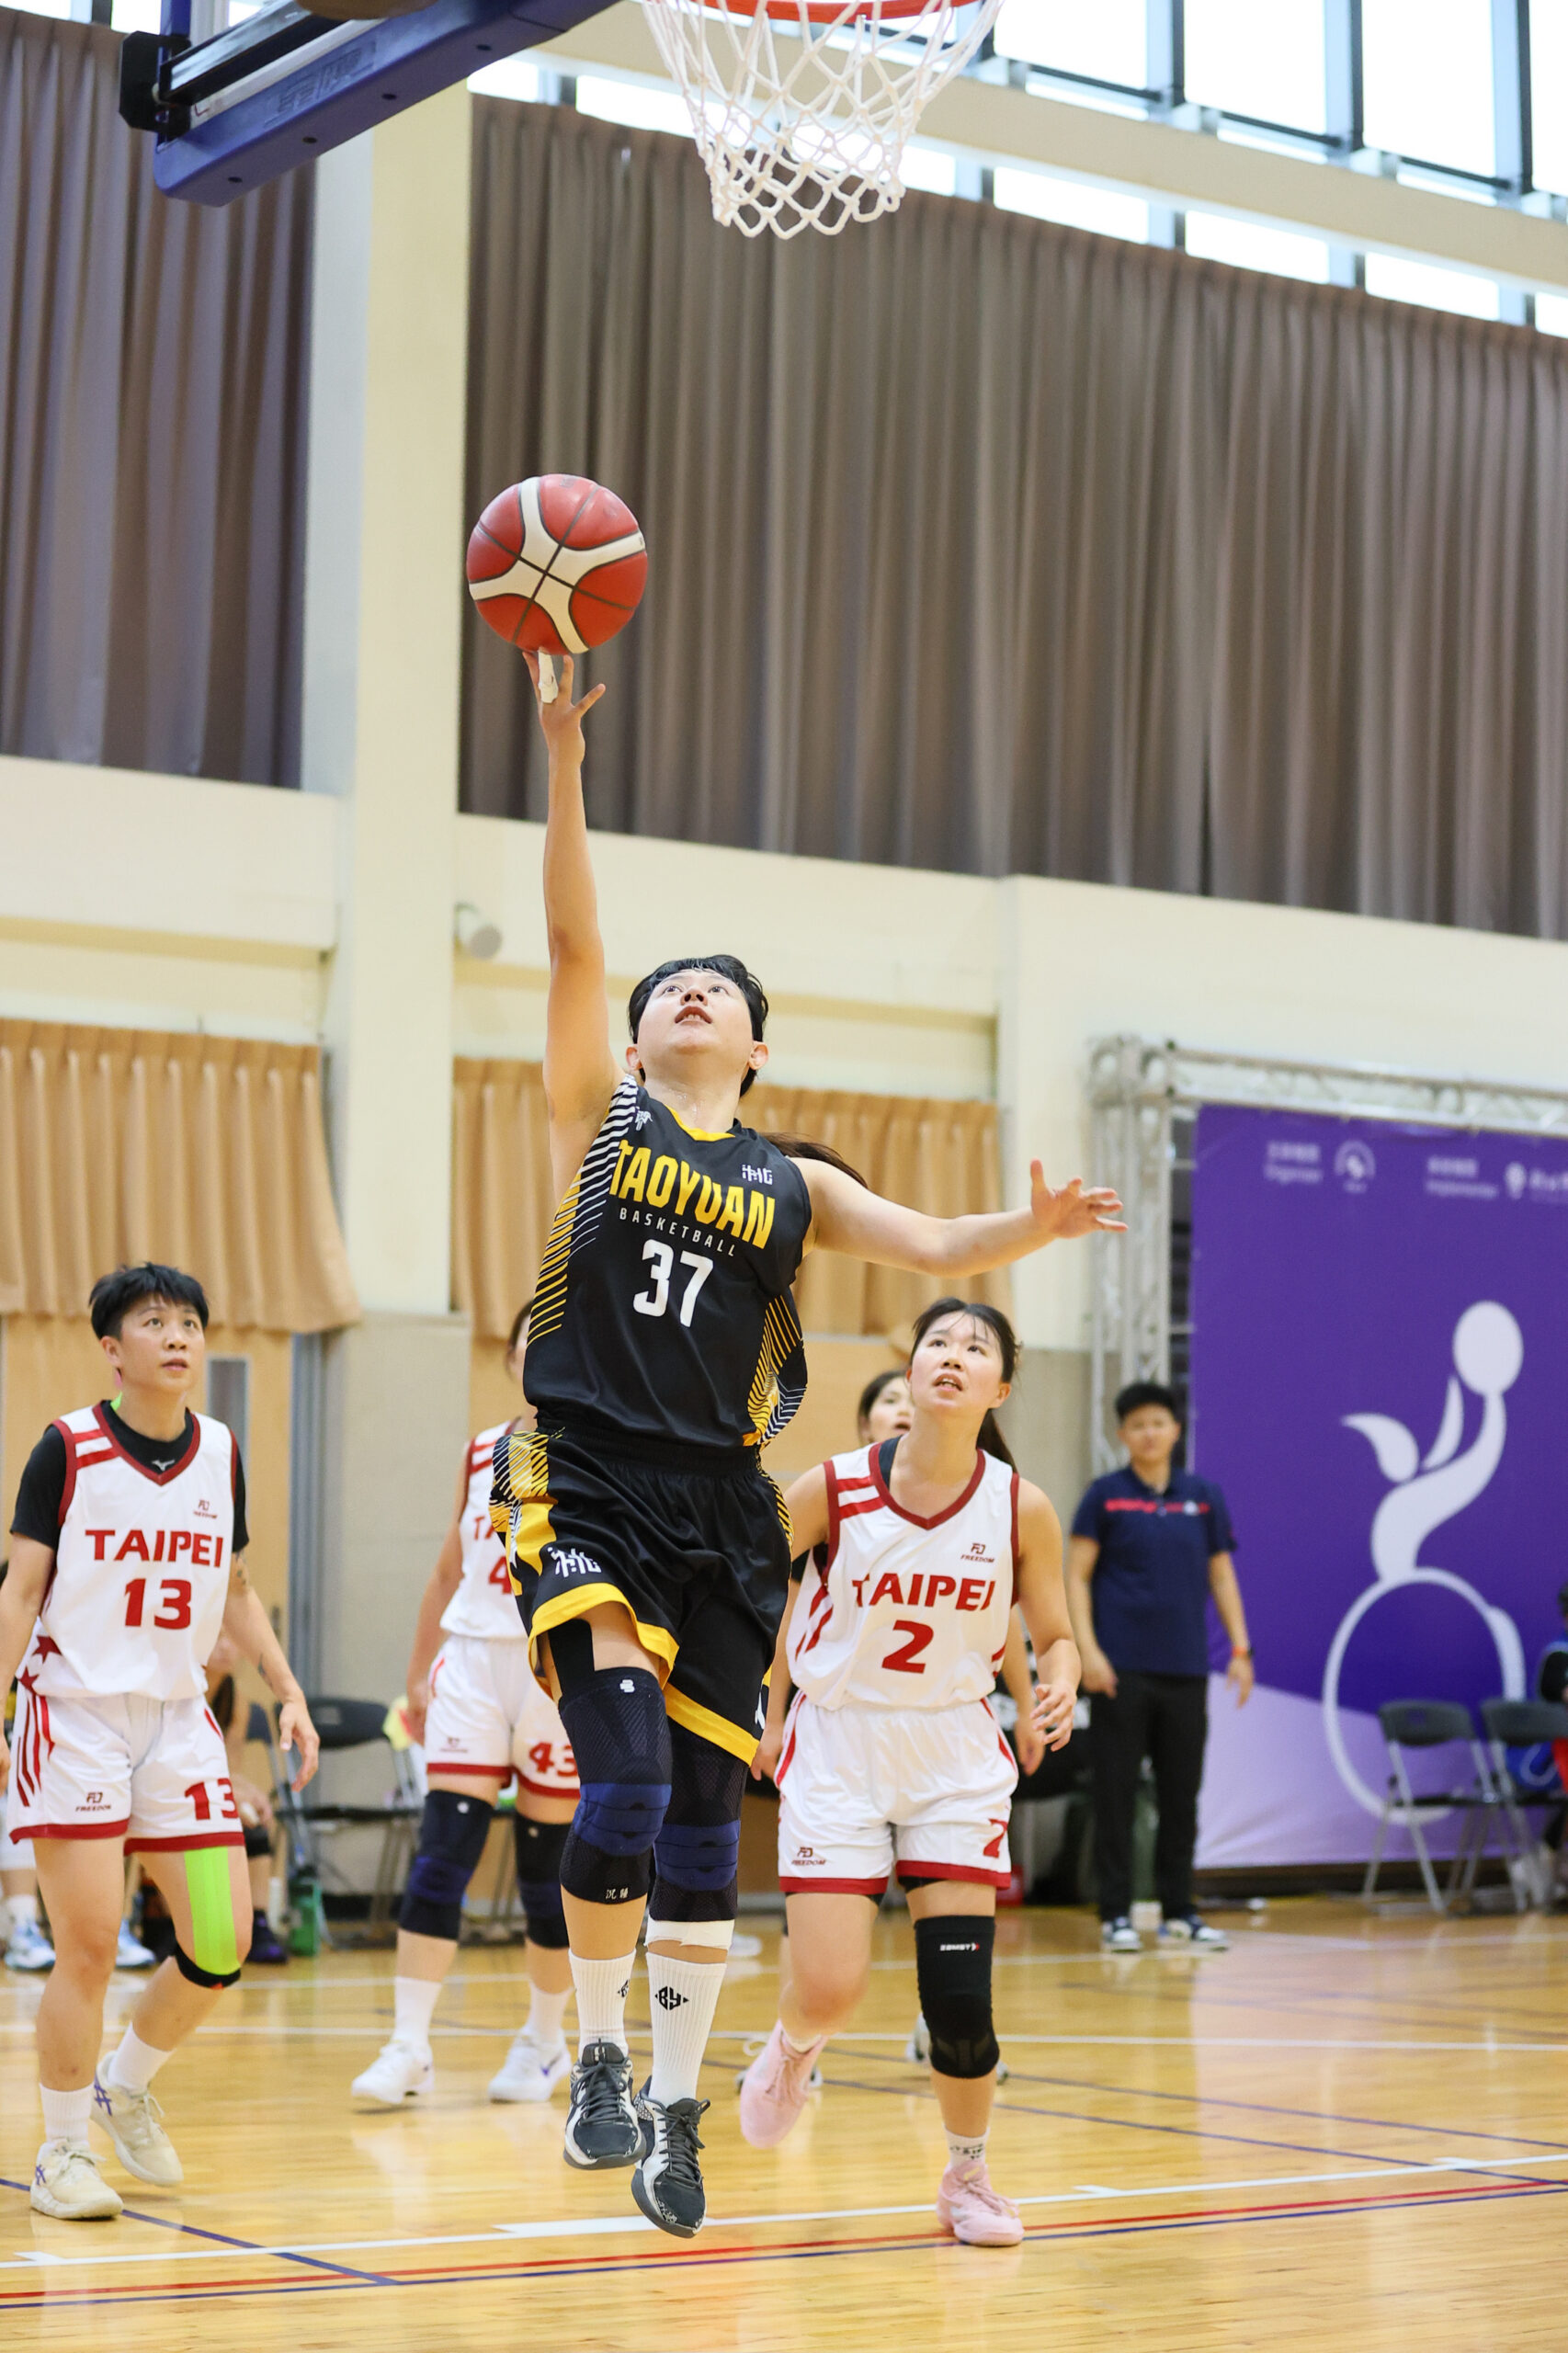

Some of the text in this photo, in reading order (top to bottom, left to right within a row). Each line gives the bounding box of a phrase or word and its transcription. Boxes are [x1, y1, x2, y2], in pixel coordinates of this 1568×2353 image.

[608, 1139, 775, 1249] TAOYUAN
[619, 1207, 735, 1257] BASKETBALL
[632, 1238, 714, 1328] 37
[85, 1529, 224, 1569] TAIPEI
[124, 1577, 192, 1631] 13
[851, 1572, 996, 1612] TAIPEI
[881, 1619, 935, 1675] 2
[528, 1741, 579, 1778] 43
[184, 1777, 240, 1822] 13
[658, 1985, 682, 2011] BY
